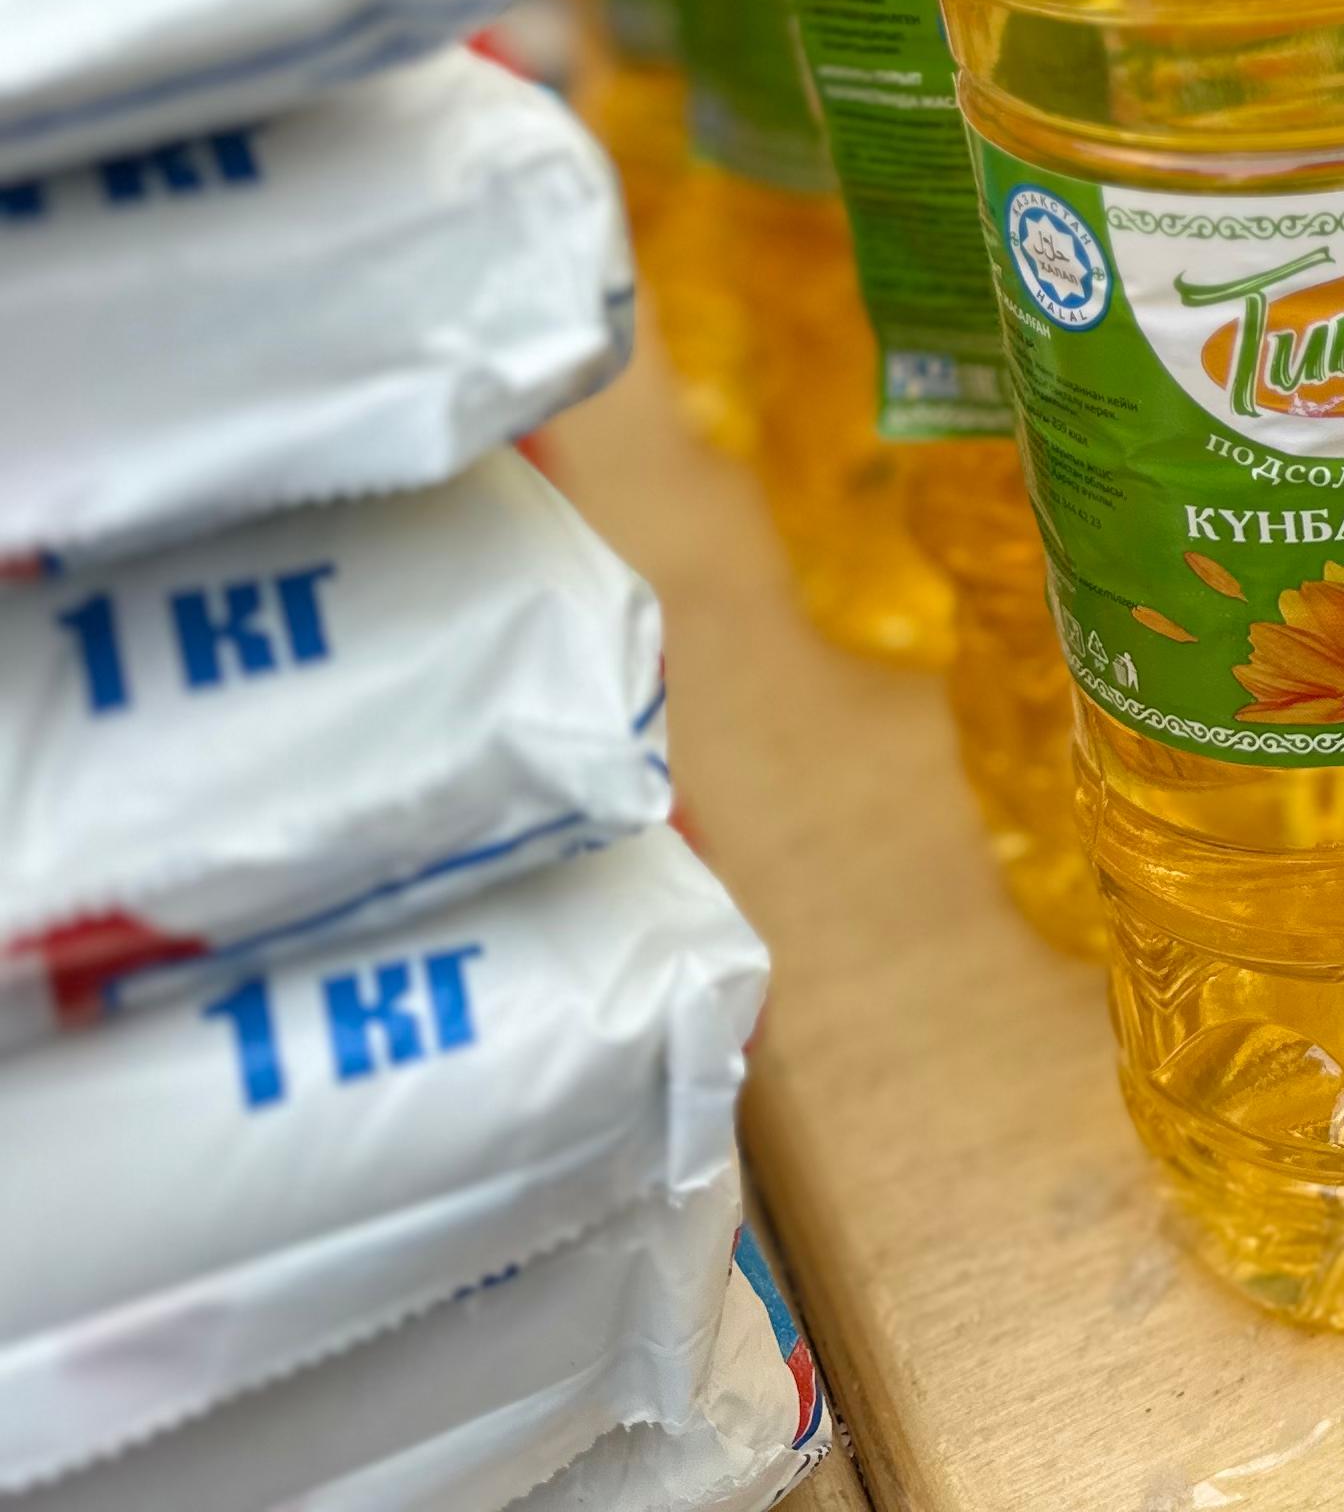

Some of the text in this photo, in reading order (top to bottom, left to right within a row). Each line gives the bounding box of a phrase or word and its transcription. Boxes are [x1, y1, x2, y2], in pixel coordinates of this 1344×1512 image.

[1035, 289, 1089, 322] HALAL
[56, 590, 131, 714] 1
[201, 974, 286, 1113] 1
